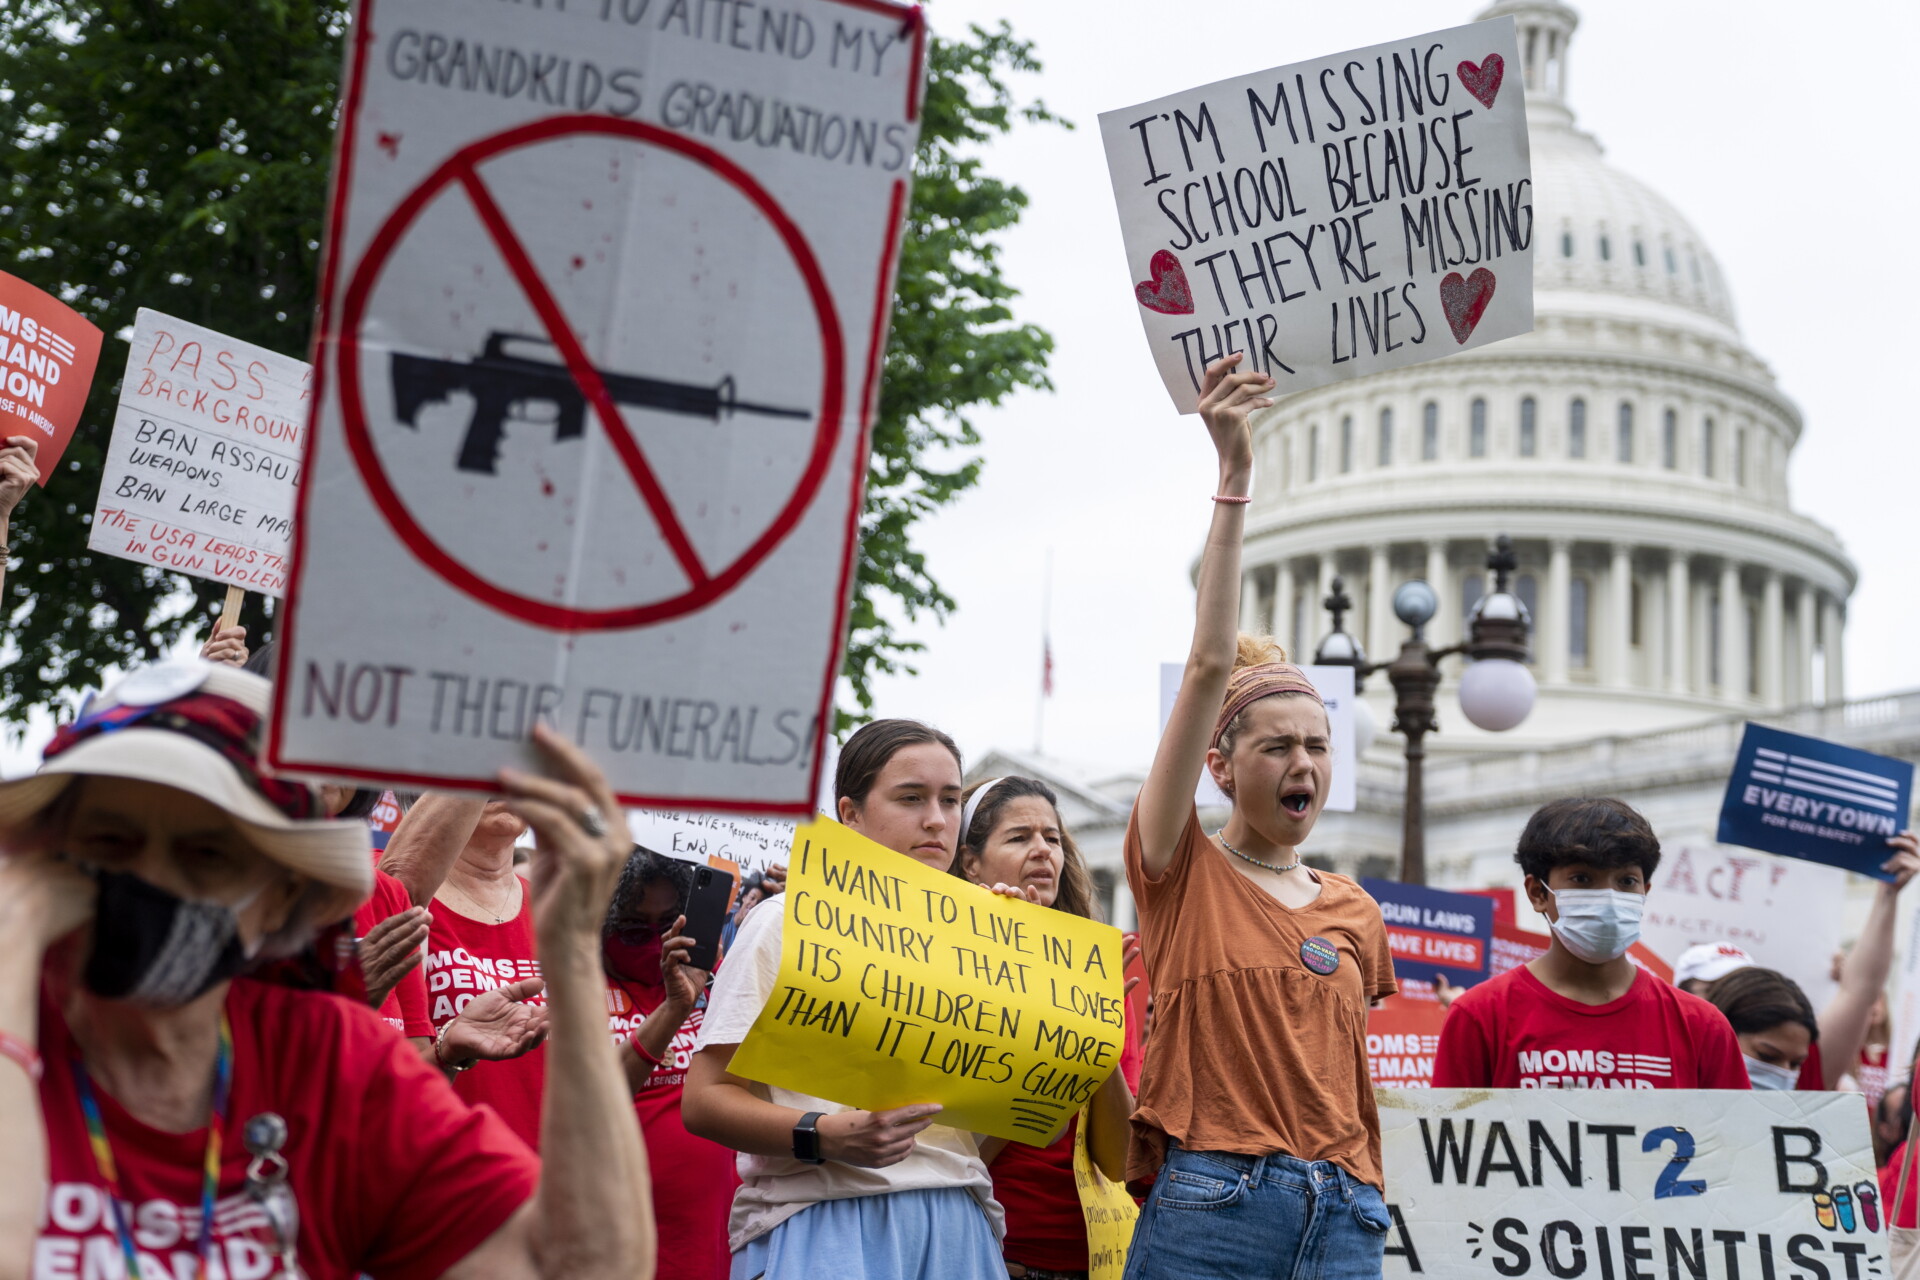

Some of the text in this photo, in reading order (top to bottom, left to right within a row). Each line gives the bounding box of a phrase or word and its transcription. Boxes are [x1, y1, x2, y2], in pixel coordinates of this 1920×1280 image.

[659, 0, 815, 61] ATTEND
[829, 21, 897, 77] MY
[387, 29, 908, 172] GRANDKIDS GRADUATIONS
[1130, 43, 1451, 187] I'M MISSING
[1157, 109, 1482, 251] SCHOOL BECAUSE
[1194, 178, 1534, 317] THEY'RE MISSING
[0, 304, 39, 344] MS
[1171, 282, 1427, 397] THEIR LIVES
[147, 330, 270, 402] PASS
[16, 404, 28, 419] IN
[28, 410, 56, 438] AMERICA
[135, 419, 200, 458] BAN
[129, 446, 224, 489] WEAPONS
[115, 474, 168, 505] BAN
[179, 493, 249, 529] LARGE
[150, 525, 196, 550] USA
[203, 536, 259, 566] LEADS
[150, 545, 205, 573] GUN
[305, 660, 822, 770] NOT THEIR FUNERALS!
[686, 811, 719, 831] LOVE
[773, 838, 792, 857] oth
[1742, 783, 1897, 836] EVERYTOWN
[1761, 812, 1865, 846] FOR GUN SAFETY
[800, 839, 1108, 981] I WANT TO LIVE IN A
[1379, 901, 1477, 935] GUN LAWS
[427, 947, 516, 979] MOMS
[793, 890, 935, 964] COUNTRY
[951, 946, 1032, 994] THAT
[1050, 978, 1124, 1030] LOVES
[1424, 937, 1478, 963] LIVES
[797, 938, 1117, 1069] ITS CHILDREN MORE
[774, 985, 1101, 1104] THAN IT LOVES GUNS
[1517, 1049, 1616, 1075] MOMS
[653, 1074, 683, 1087] SENSE
[1770, 1125, 1829, 1194] B
[41, 1182, 182, 1250] OMS
[1491, 1216, 1868, 1280] SCIENTIST
